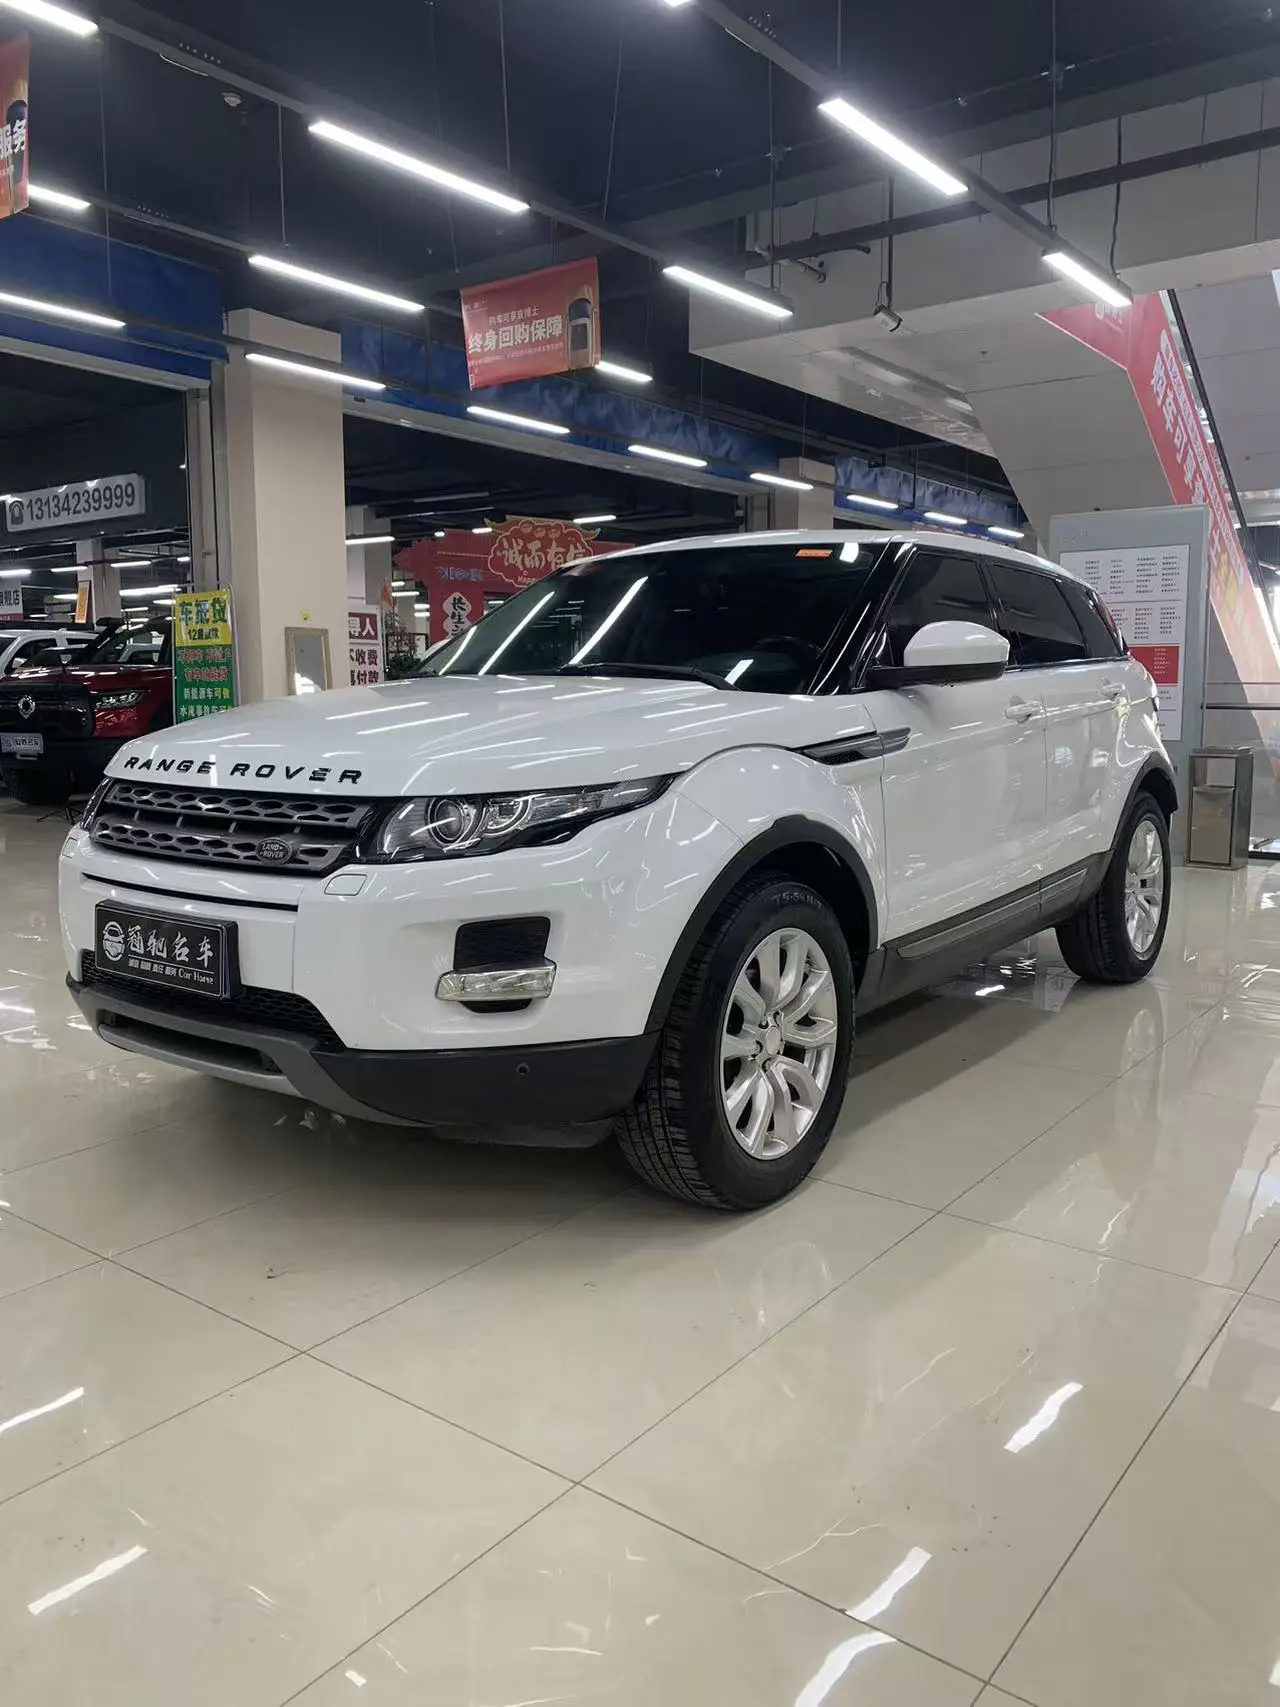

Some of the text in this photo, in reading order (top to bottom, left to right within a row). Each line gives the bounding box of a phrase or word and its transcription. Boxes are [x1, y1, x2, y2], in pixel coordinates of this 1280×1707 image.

[468, 314, 563, 354] 终身回购保障
[26, 482, 135, 521] 13134239999
[123, 756, 363, 785] RANGE ROVER
[262, 843, 280, 851] LAND
[263, 850, 284, 859] ROVER
